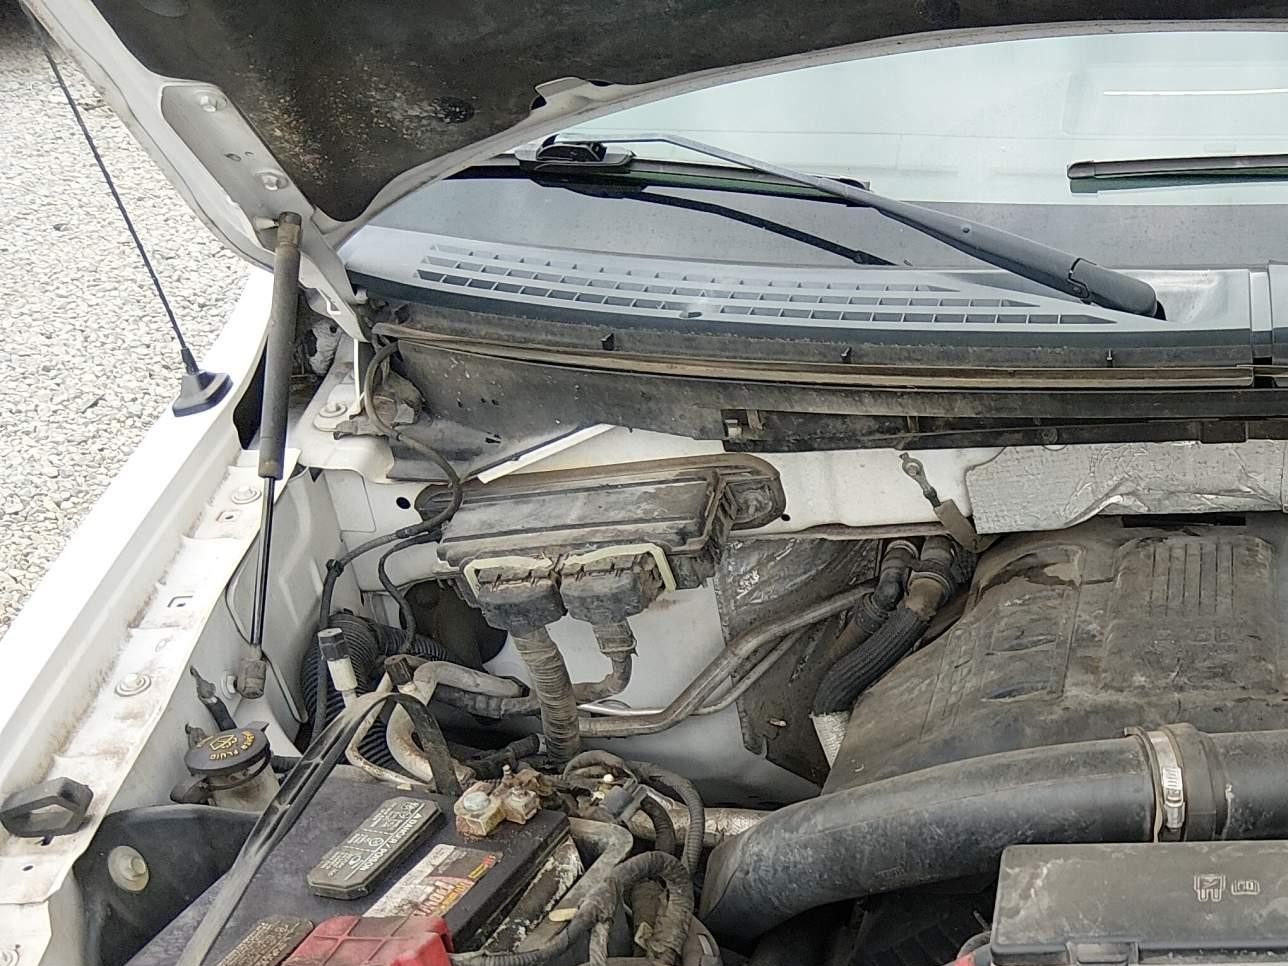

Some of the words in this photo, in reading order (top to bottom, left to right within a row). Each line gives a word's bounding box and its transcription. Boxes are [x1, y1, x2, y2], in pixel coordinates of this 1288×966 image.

[209, 749, 239, 760] FLUID
[390, 818, 418, 844] DANGER
[359, 847, 388, 871] POISON
